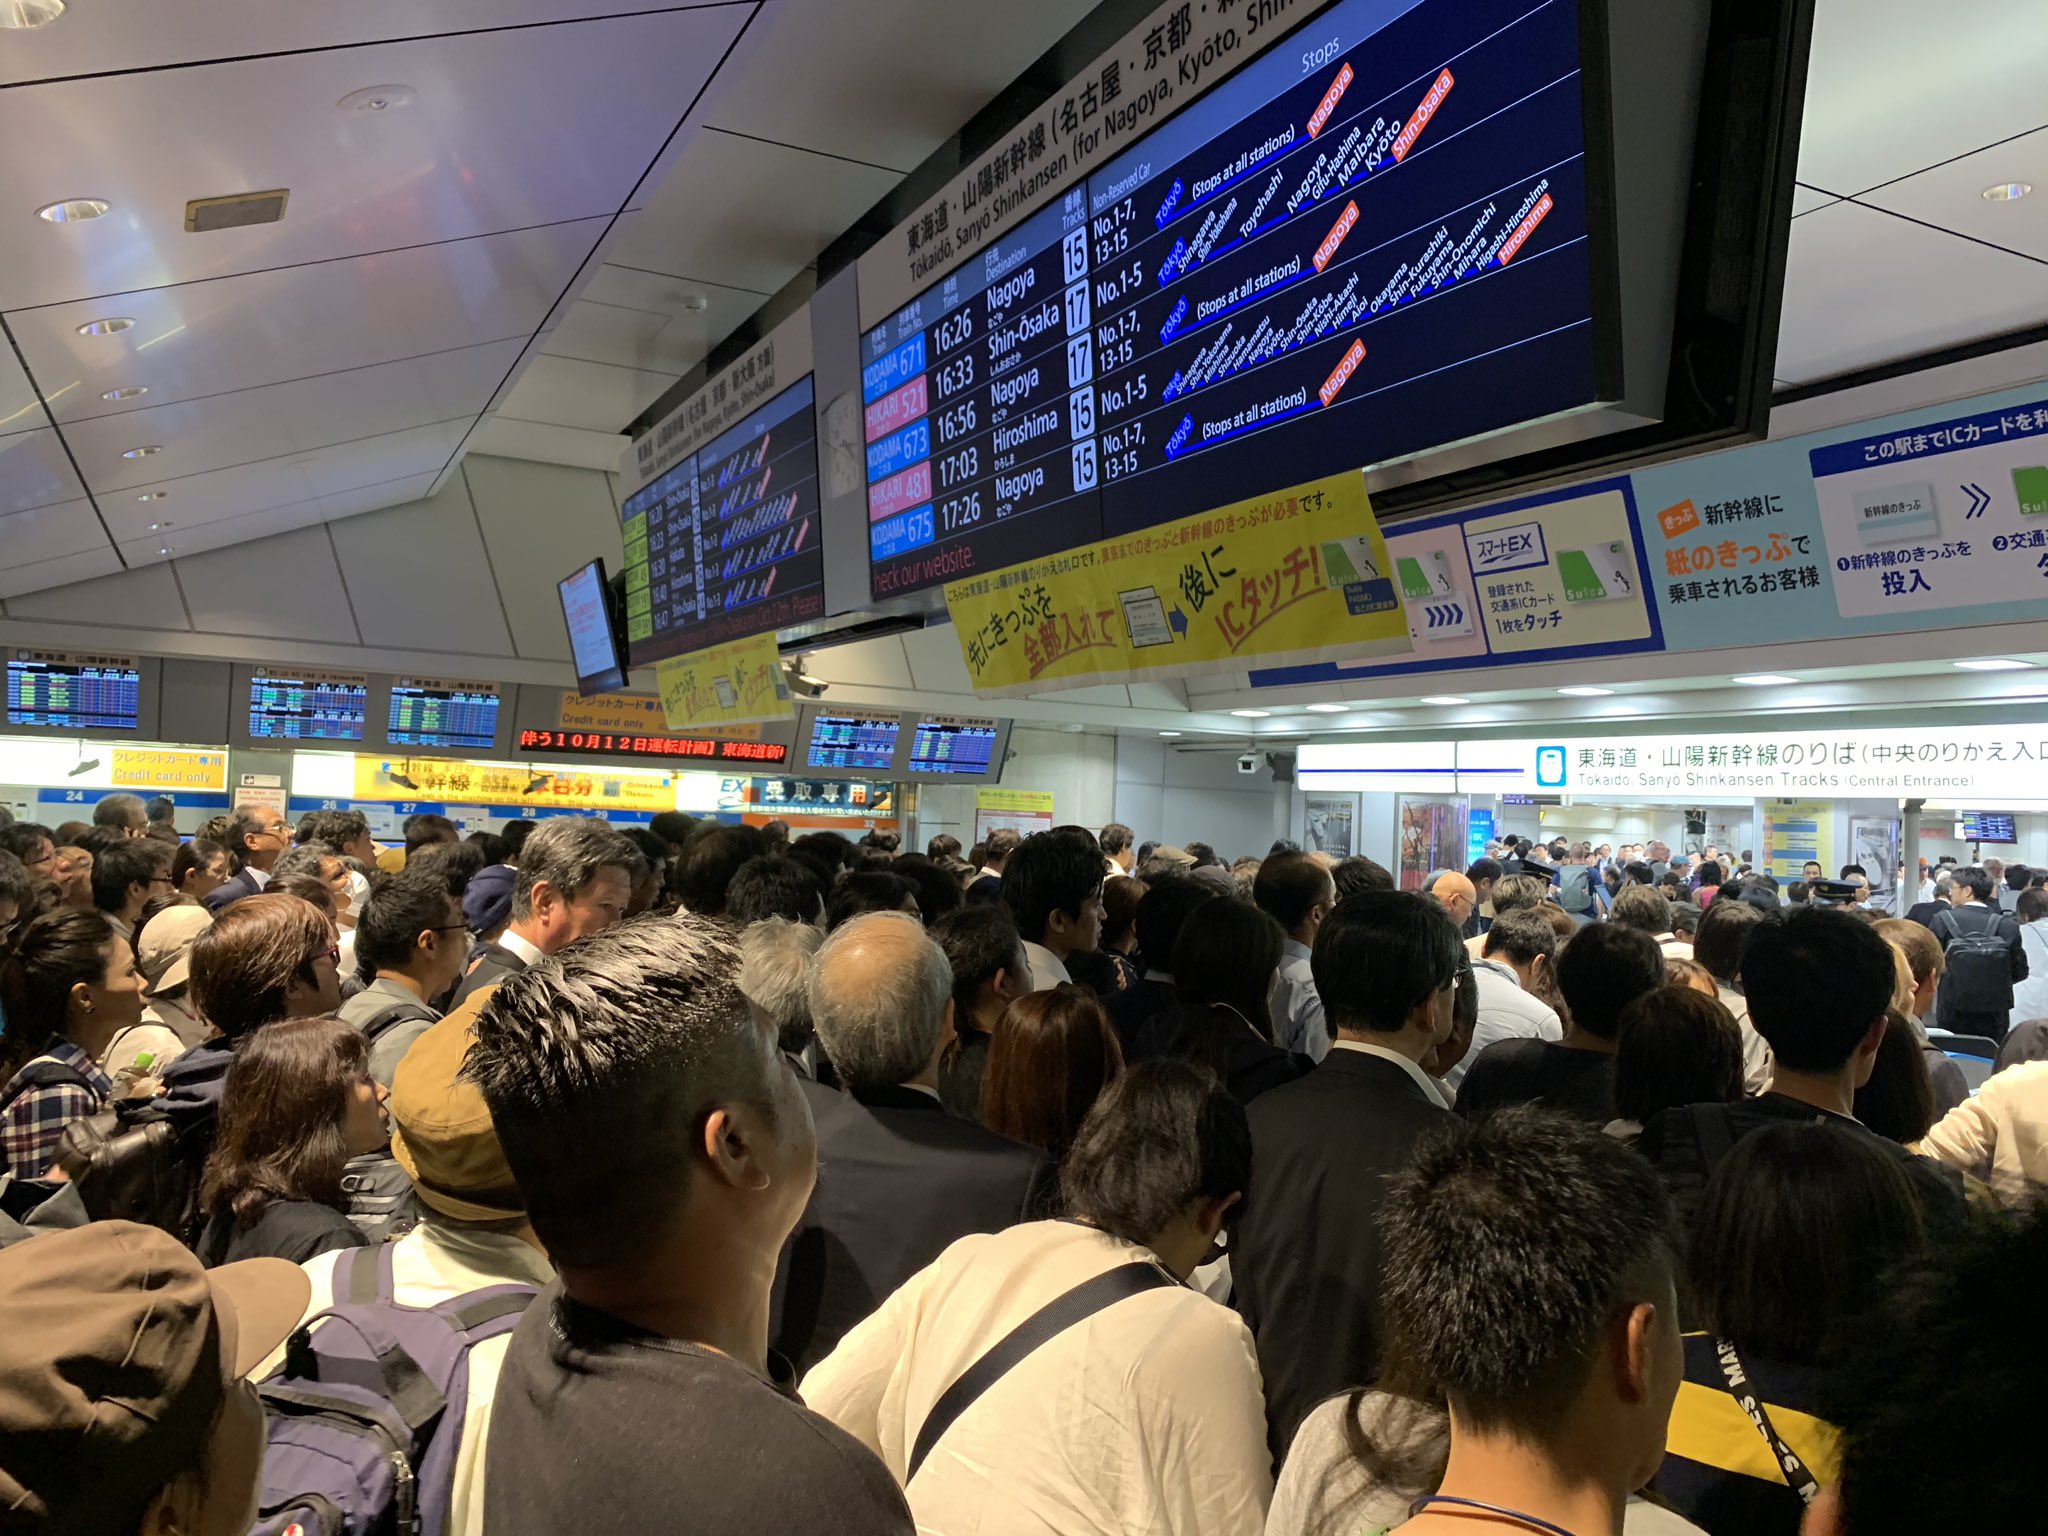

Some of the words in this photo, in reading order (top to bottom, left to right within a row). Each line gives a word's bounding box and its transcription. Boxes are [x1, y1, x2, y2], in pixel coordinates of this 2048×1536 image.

[910, 245, 954, 283] Tōkaidō,
[956, 206, 992, 253] Sanyō
[993, 151, 1067, 223] Shinkansen
[1072, 129, 1099, 165] (for
[1105, 78, 1174, 146] Nagoya,
[1178, 24, 1242, 86] Kyōto,
[986, 246, 1027, 283] Destination
[1094, 168, 1136, 210] Non-Reserved
[1137, 162, 1151, 182] Car
[1301, 36, 1340, 74] Stops
[1155, 182, 1182, 224] Tōkyō
[1192, 166, 1223, 201] (Stops
[1224, 166, 1234, 183] at
[1235, 153, 1247, 176] all
[1248, 123, 1295, 171] stations)
[1308, 69, 1351, 135] Nagoya
[1159, 241, 1185, 284] Tōkyō
[1178, 210, 1215, 273] Shinagawa
[1197, 197, 1238, 264] Shin-Yokohama
[1239, 171, 1284, 237] Toyohashi
[1287, 153, 1327, 214] Nagoya
[1311, 126, 1361, 201] Gifu-Hashima
[1337, 115, 1386, 187] Maibara
[1364, 119, 1401, 173] Kyōto
[1392, 72, 1453, 159] Shin-Ōsaka
[1475, 178, 1550, 272] Higashi-Hiroshima
[1499, 197, 1552, 263] Hiroshima
[1095, 228, 1129, 264] 13-15
[1389, 225, 1449, 307] Shin-Kurashiki
[1430, 202, 1497, 290] Shin-Onomichi
[1453, 237, 1487, 281] Mihara
[1160, 300, 1187, 344] Tōkyō
[1196, 292, 1227, 320] (Stops
[1228, 291, 1238, 308] at
[1239, 280, 1252, 303] all
[1254, 255, 1301, 296] stations)
[1313, 206, 1358, 271] Nagoya
[1369, 262, 1409, 314] Okayama
[1410, 239, 1455, 298] Fukuyama
[864, 359, 898, 389] KODAMA
[900, 344, 922, 376] 671
[934, 308, 972, 356] 16:26
[987, 265, 1035, 314] Nagoya
[1065, 234, 1085, 274] 15
[1279, 297, 1318, 352] Shin-Ōsaka
[1296, 292, 1334, 347] Shin-Kōbe
[1314, 274, 1359, 338] Nishi-Akashi
[1331, 295, 1358, 332] Himeji
[1350, 297, 1369, 323] Aioi
[866, 393, 899, 422] HIKARI
[901, 385, 925, 416] 521
[935, 355, 974, 401] 16:33
[988, 303, 1059, 361] Shin-Ōsaka
[1067, 285, 1088, 326] 17
[1100, 339, 1133, 372] 13-15
[1190, 322, 1233, 391] Shin-Yokohama
[1218, 335, 1246, 378] Shizuoka
[1233, 316, 1271, 372] Hamamatsu
[1248, 327, 1274, 365] Nagoya
[1263, 328, 1285, 359] Kyōto
[1176, 347, 1207, 394] Shinagawa
[1204, 345, 1230, 384] Mishima
[867, 435, 901, 465] KODAMA
[903, 430, 926, 461] 673
[937, 400, 976, 444] 16:56
[990, 365, 1039, 408] Nagoya
[1069, 340, 1090, 380] 17
[1165, 417, 1192, 459] Tōkyō
[1202, 412, 1232, 441] (Stops
[1233, 407, 1244, 425] at
[1245, 398, 1257, 420] all
[1258, 386, 1306, 417] stations)
[1319, 343, 1364, 405] Nagoya
[870, 481, 903, 506] HIKARI
[905, 469, 930, 500] 481
[939, 446, 978, 488] 17:03
[992, 409, 1058, 455] Hiroshima
[1072, 392, 1091, 433] 15
[1104, 449, 1138, 480] 13-15
[872, 521, 906, 547] KODAMA
[908, 512, 932, 543] 675
[942, 492, 981, 531] 17:26
[995, 465, 1044, 503] Nagoya
[1074, 446, 1094, 485] 15
[1704, 495, 1784, 526] 新幹線に
[1864, 499, 1922, 518] 新幹線のきっぷ
[1664, 508, 1694, 530] きっぷ
[899, 563, 921, 587] our
[923, 545, 976, 580] website.
[1477, 533, 1532, 559] スマートEX
[1665, 532, 1811, 576] 紙のきっぷで
[1178, 544, 1238, 612] 後に
[1487, 580, 1535, 598] 登録された
[1567, 586, 1604, 600] Suica
[1668, 565, 1821, 604] 乗車されるお客様
[1881, 568, 1932, 596] 投入
[1490, 593, 1555, 614] 交通系ICカード
[1496, 609, 1563, 634] 1枚をタッチ
[967, 585, 1056, 676] 先にきっぷを
[1022, 608, 1117, 678] 全部入れて
[562, 713, 592, 725] Credit
[598, 715, 620, 727] card
[624, 718, 644, 729] only
[115, 752, 221, 766] クレジットカード専用
[115, 769, 150, 781] Credit
[156, 770, 181, 781] card
[187, 771, 210, 783] only
[66, 792, 83, 801] 24
[720, 779, 746, 793] EX
[765, 780, 867, 804] 受取専用
[1686, 772, 1773, 786] Shinkansen
[1781, 772, 1838, 786] Tracks
[1845, 774, 1898, 787] (Central
[1904, 774, 1974, 787] Entrance)
[322, 800, 337, 810] 26
[402, 803, 417, 813] 27
[522, 808, 536, 817] 28
[595, 811, 608, 819] 29
[864, 819, 876, 828] 32
